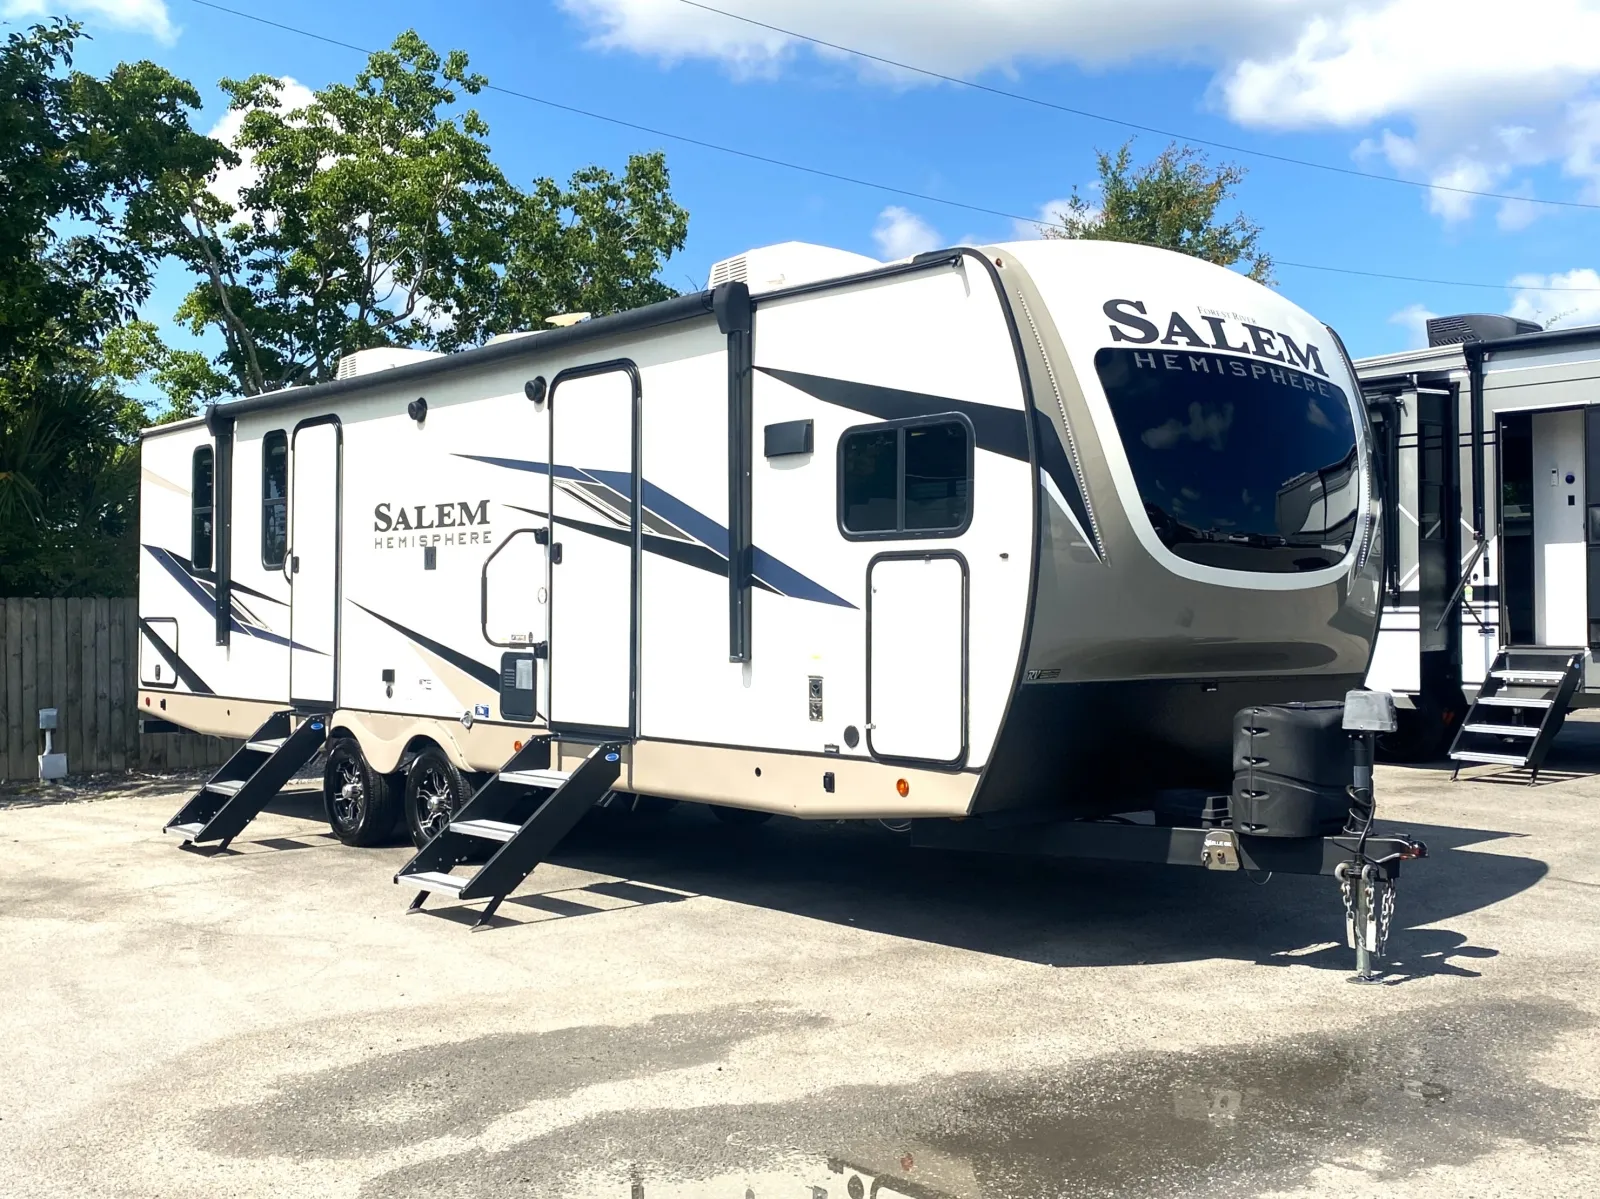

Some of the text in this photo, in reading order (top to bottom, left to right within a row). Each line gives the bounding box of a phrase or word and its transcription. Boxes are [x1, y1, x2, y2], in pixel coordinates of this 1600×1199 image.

[1102, 298, 1330, 378] SALEM
[1133, 351, 1331, 398] HEMISPHERE
[374, 499, 491, 533] SALEM
[374, 530, 492, 549] HEMISPHERE
